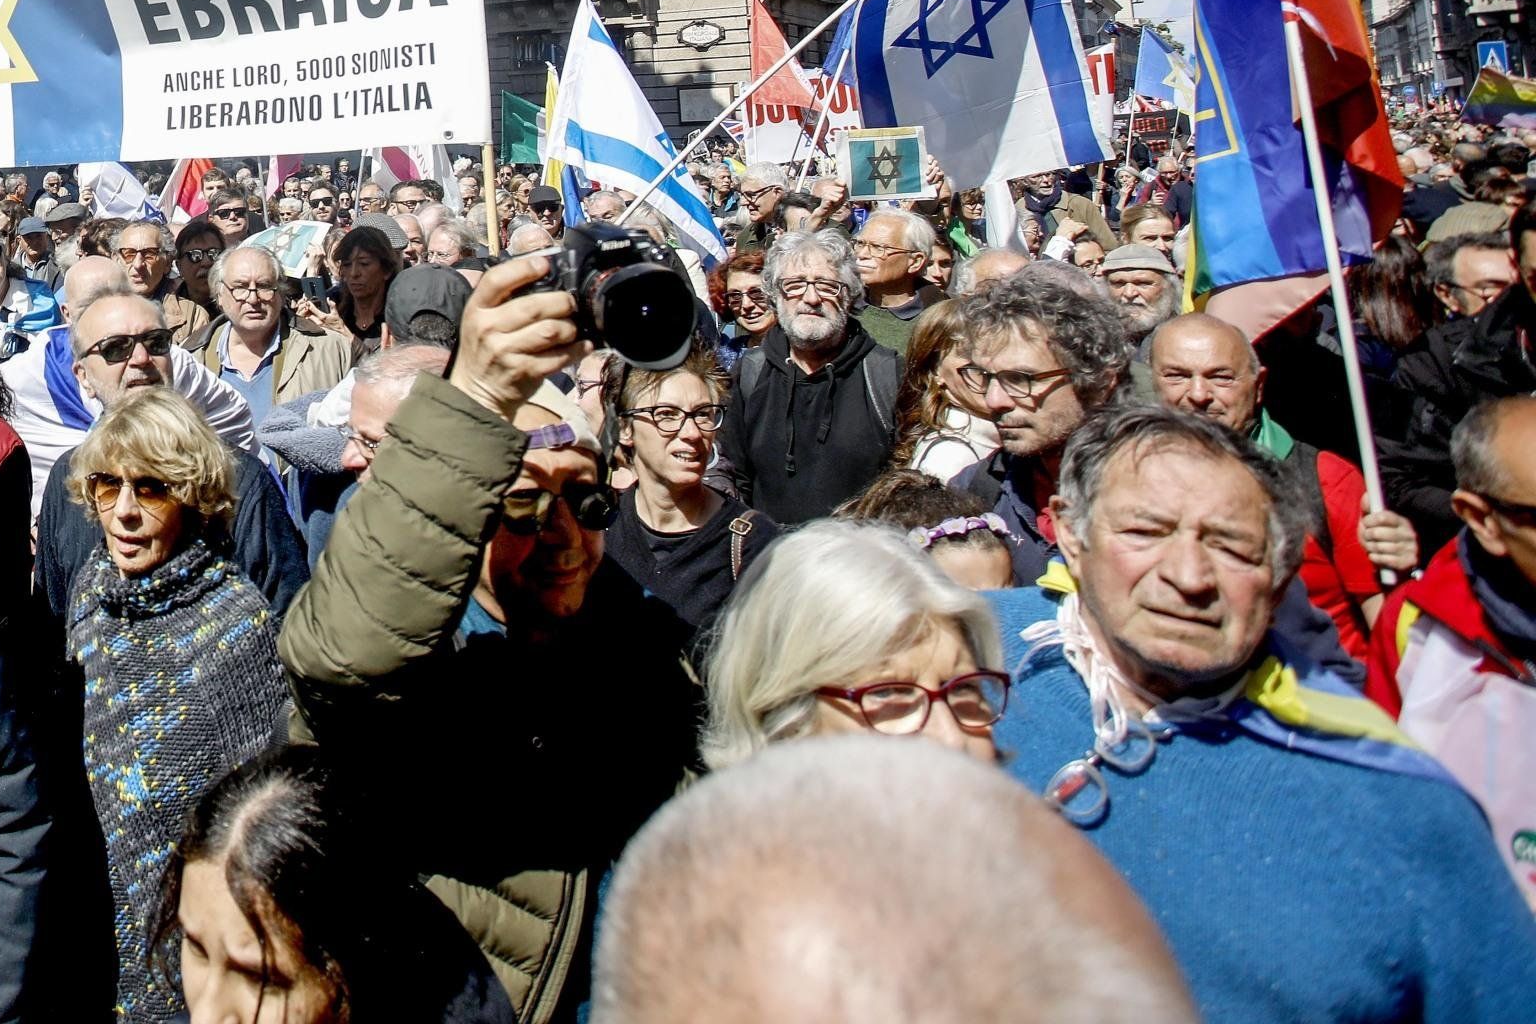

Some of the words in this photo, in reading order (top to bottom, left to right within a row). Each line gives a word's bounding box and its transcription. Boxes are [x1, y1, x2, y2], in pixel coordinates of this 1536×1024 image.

[163, 68, 225, 93] ANCHE
[232, 63, 288, 87] LORO,
[296, 55, 346, 82] 5000
[351, 42, 435, 75] SIONISTI
[166, 94, 323, 130] LIBERARONO
[333, 81, 433, 119] L'ITALIA
